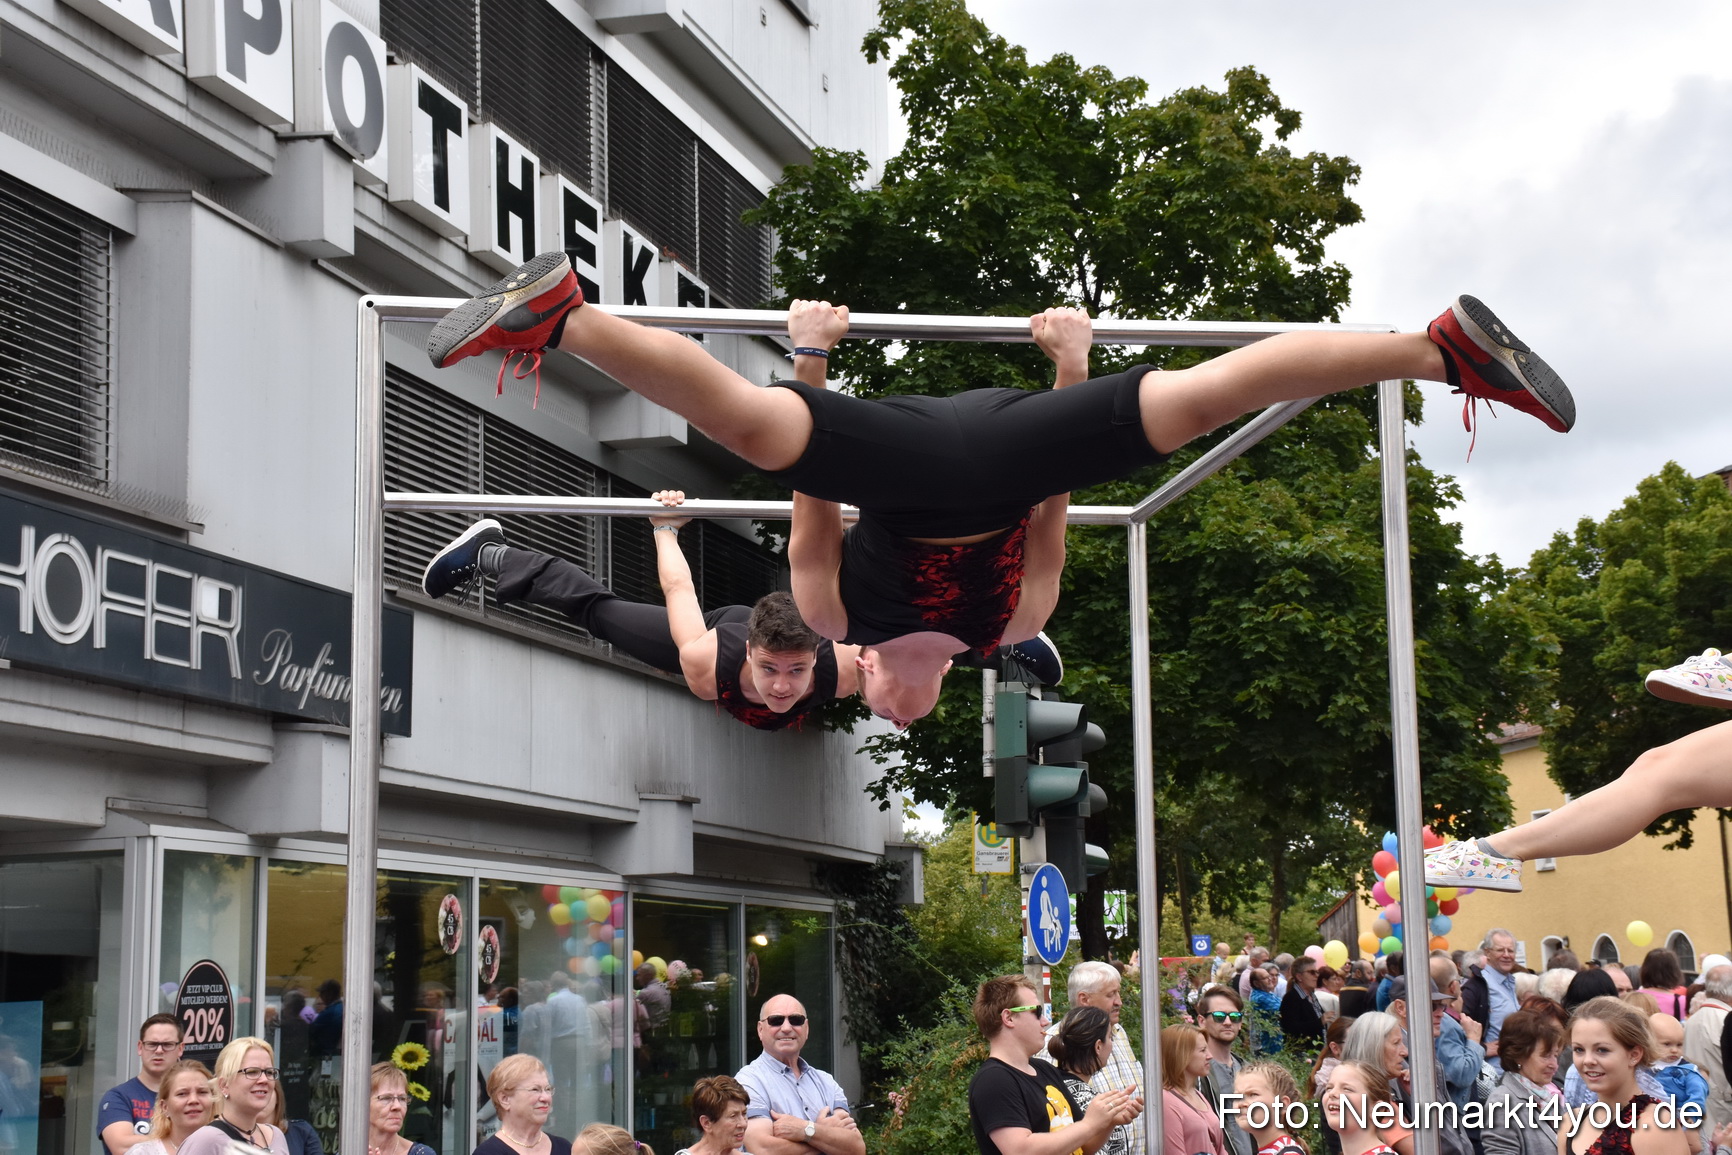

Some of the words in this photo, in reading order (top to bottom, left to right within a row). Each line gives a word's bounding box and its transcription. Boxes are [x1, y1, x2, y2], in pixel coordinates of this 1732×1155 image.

[115, 0, 706, 344] POTHEKE
[252, 628, 404, 714] Parfümen
[181, 996, 205, 1005] MITGLIED
[186, 985, 200, 993] JETZT
[201, 985, 210, 993] VIP
[210, 985, 223, 993] CLUB
[183, 1007, 224, 1043] 20%
